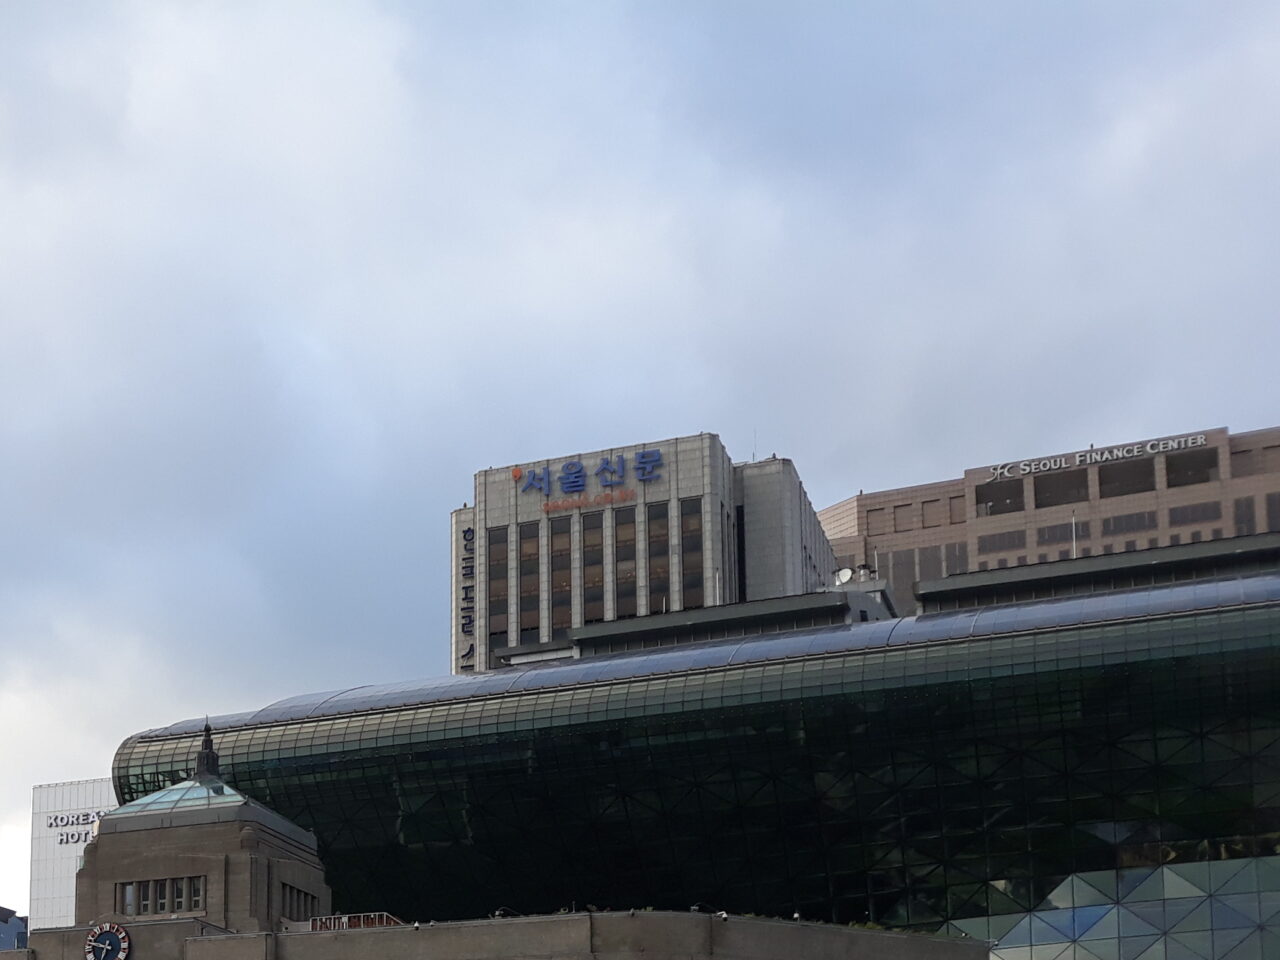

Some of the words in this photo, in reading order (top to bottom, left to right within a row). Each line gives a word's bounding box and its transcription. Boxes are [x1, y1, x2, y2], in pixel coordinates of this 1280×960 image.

[521, 448, 663, 496] 서울신문
[1019, 457, 1070, 475] SEOUL
[1075, 444, 1143, 466] FINANCE
[1146, 434, 1207, 454] CENTER
[47, 811, 104, 828] KOREA
